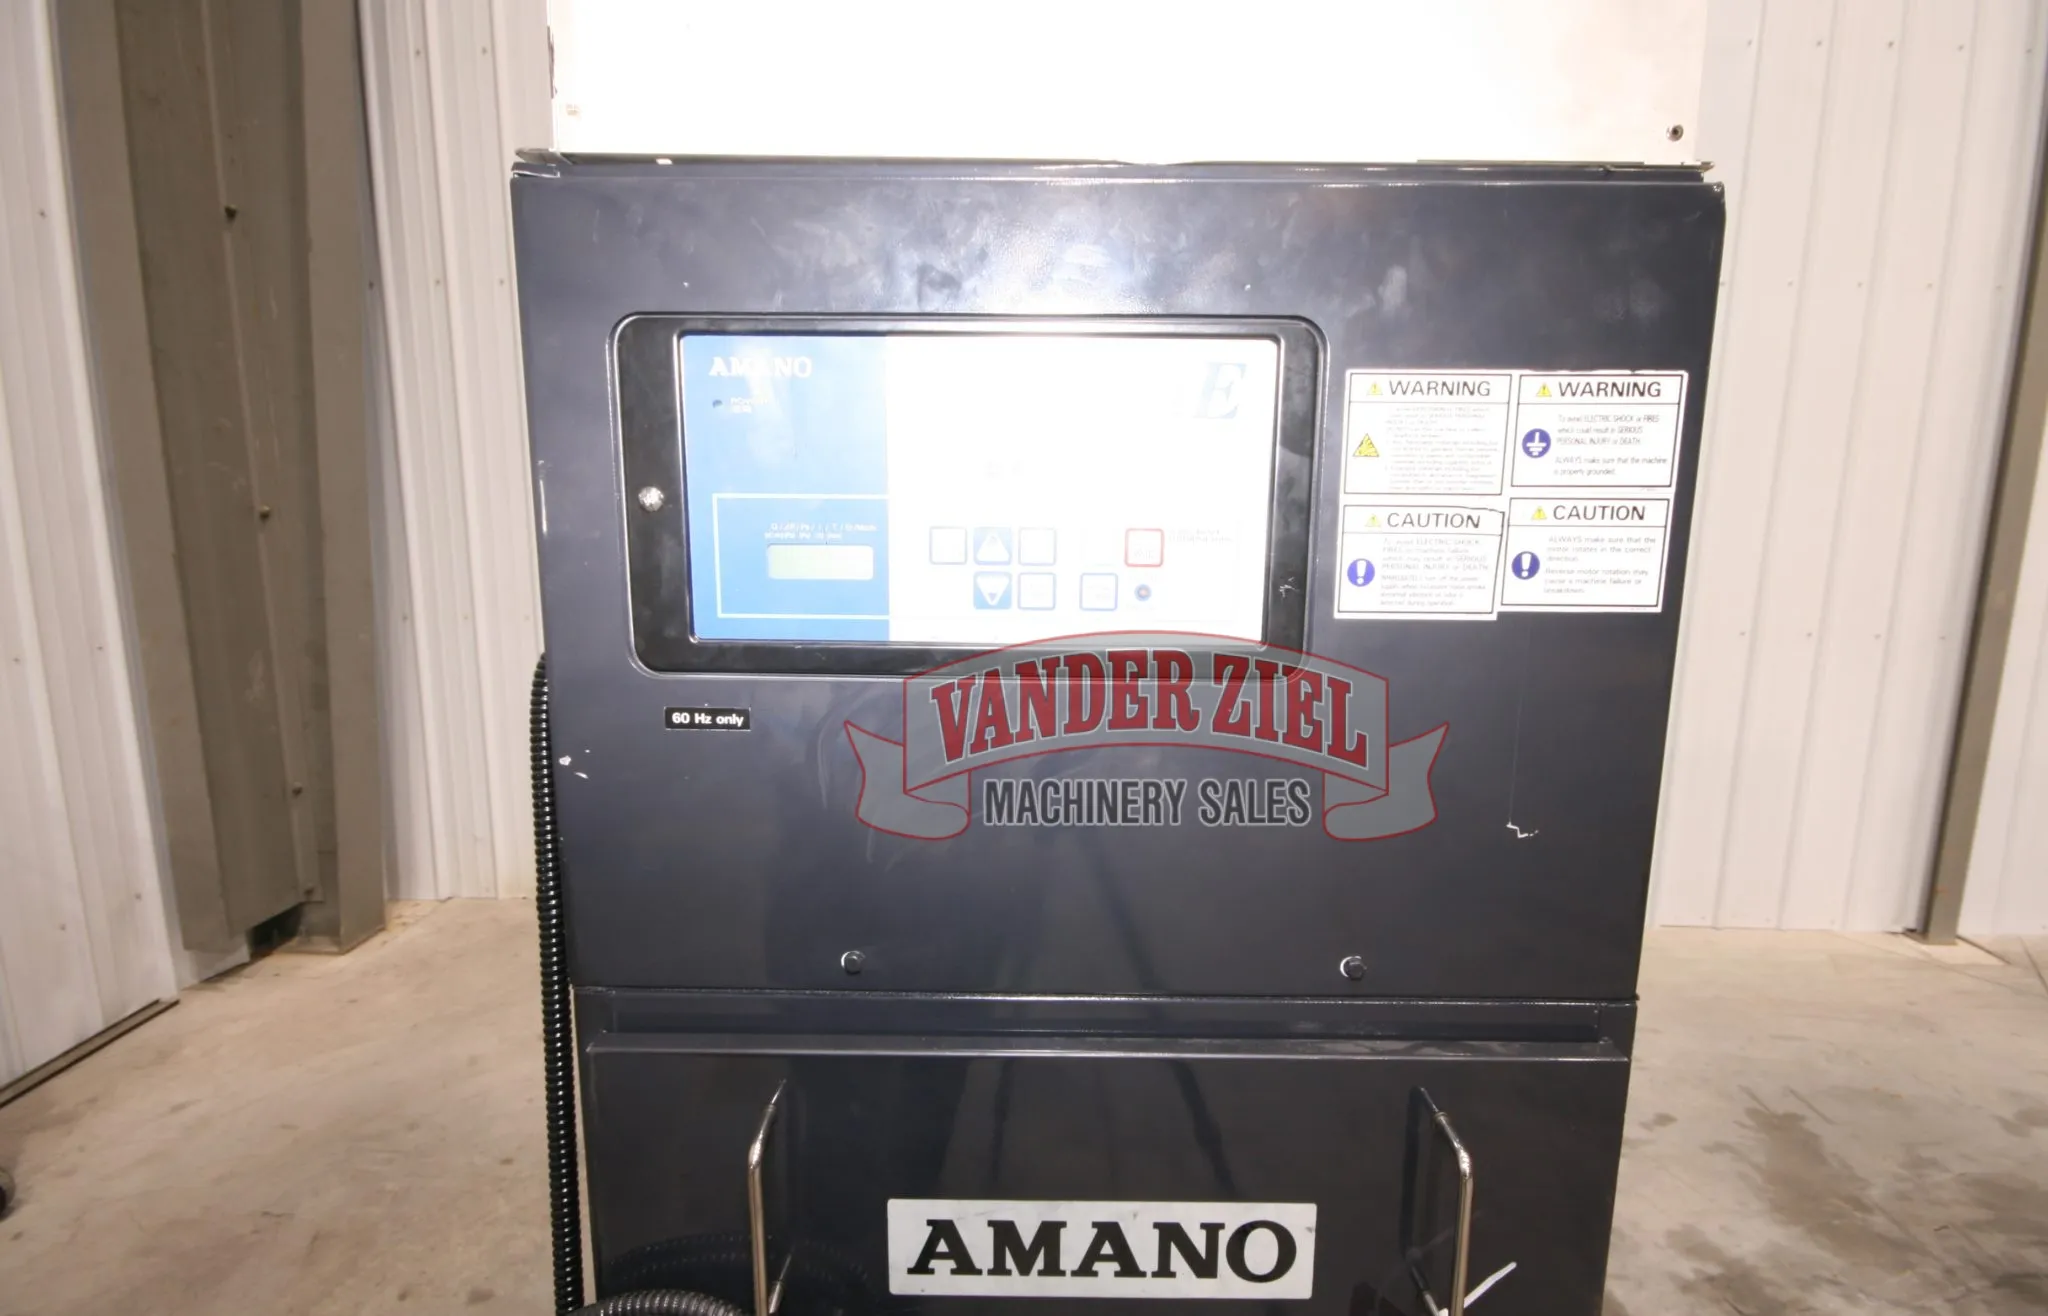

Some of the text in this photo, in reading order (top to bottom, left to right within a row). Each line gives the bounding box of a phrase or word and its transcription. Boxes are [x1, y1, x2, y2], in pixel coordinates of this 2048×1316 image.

[1389, 380, 1491, 396] WARNING
[1558, 381, 1661, 397] WARNING
[1555, 456, 1581, 464] ALWAYS
[1617, 456, 1629, 464] that
[1631, 456, 1640, 464] the
[1642, 456, 1667, 464] machine
[1387, 512, 1480, 528] CAUTION
[1553, 505, 1646, 521] CAUTION
[1548, 535, 1582, 543] ALWAYS
[1584, 535, 1605, 543] make
[1626, 535, 1641, 543] that
[1644, 535, 1656, 543] the
[671, 712, 744, 727] 60 Hz only
[906, 1219, 1298, 1284] AMANO
